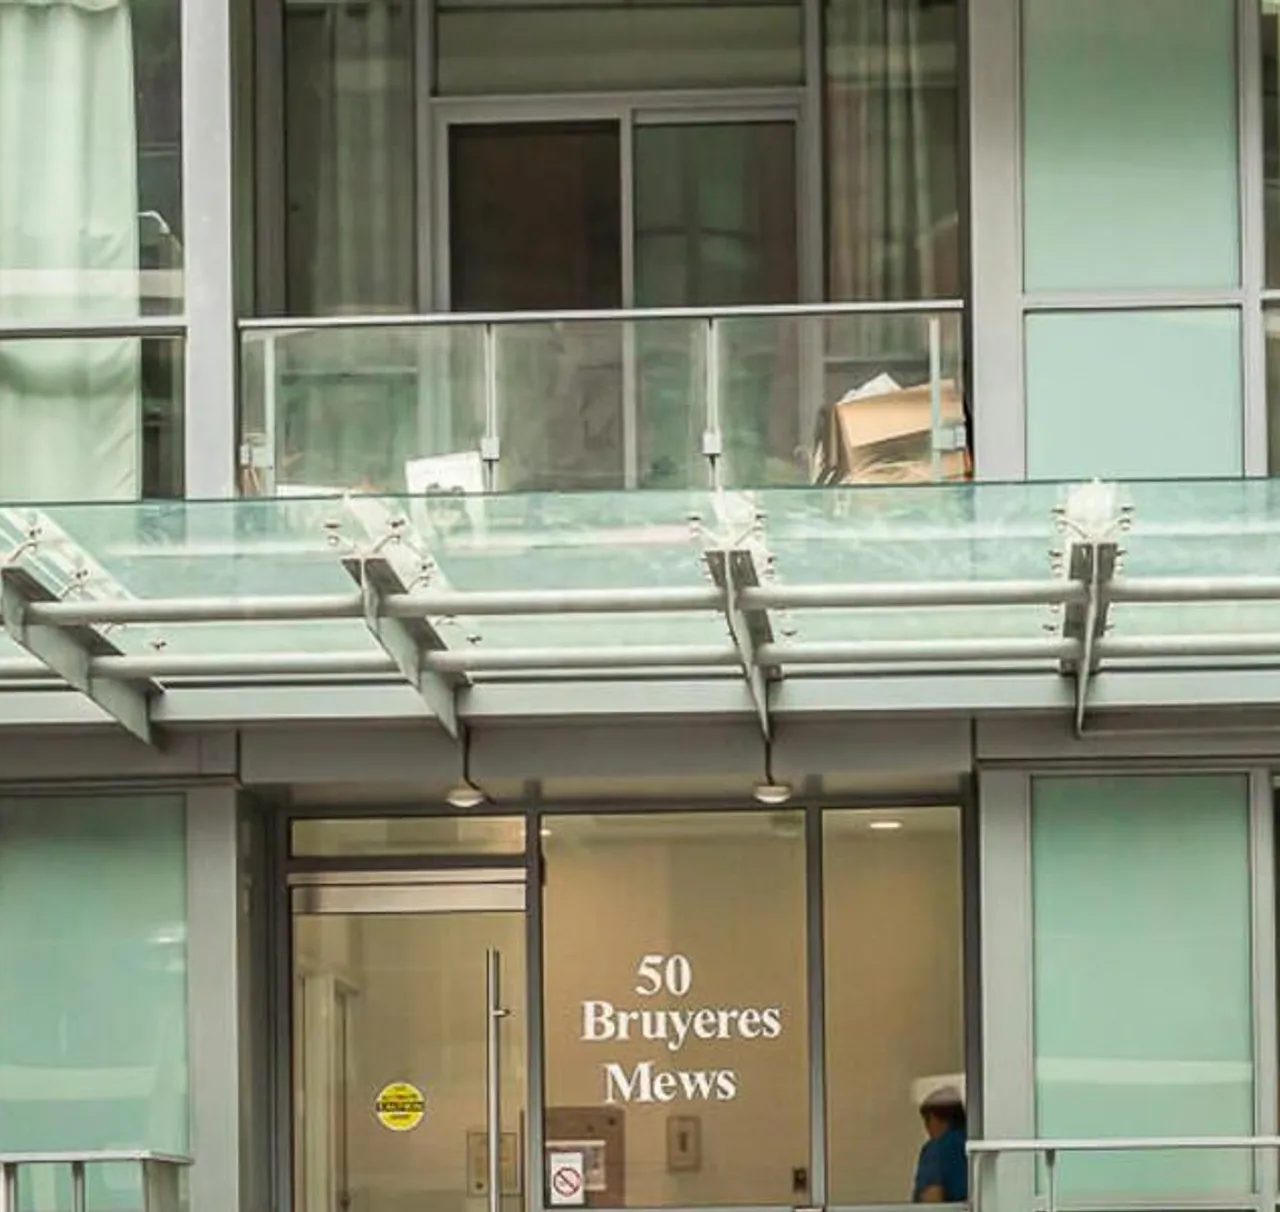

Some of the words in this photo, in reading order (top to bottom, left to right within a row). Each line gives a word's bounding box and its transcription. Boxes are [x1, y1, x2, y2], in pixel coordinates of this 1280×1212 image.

[634, 953, 693, 997] 50
[580, 1000, 782, 1051] Bruyeres
[601, 1060, 737, 1105] Mews
